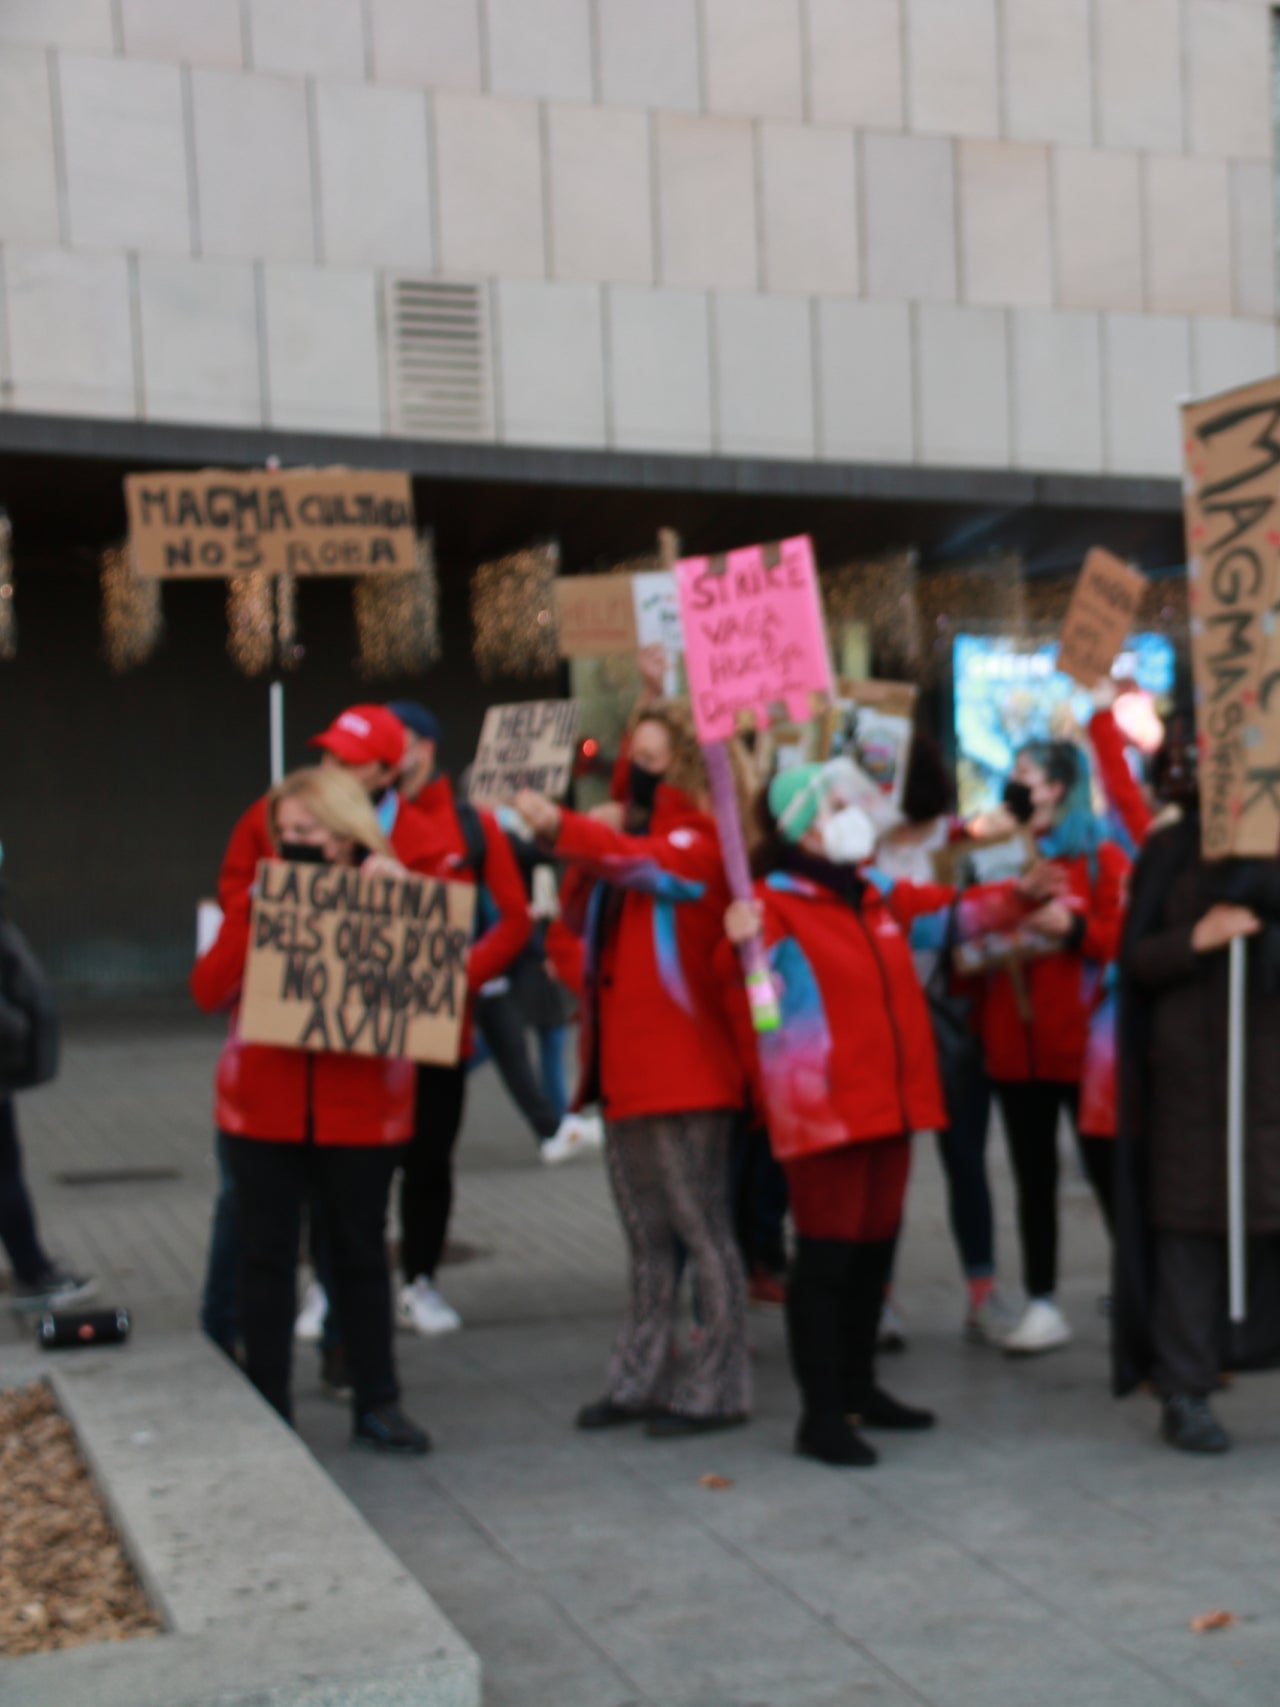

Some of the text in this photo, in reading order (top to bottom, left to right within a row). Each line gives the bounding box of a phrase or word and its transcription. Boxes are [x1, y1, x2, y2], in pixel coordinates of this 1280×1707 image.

[138, 486, 291, 532] MAGMA
[165, 535, 263, 570] NOS
[690, 556, 808, 611] STRIKE
[261, 864, 449, 925] LA GALLINA
[255, 911, 323, 954] DELS
[336, 919, 393, 965] OUS
[282, 954, 328, 1003] NO
[300, 1001, 409, 1058] AVUI
